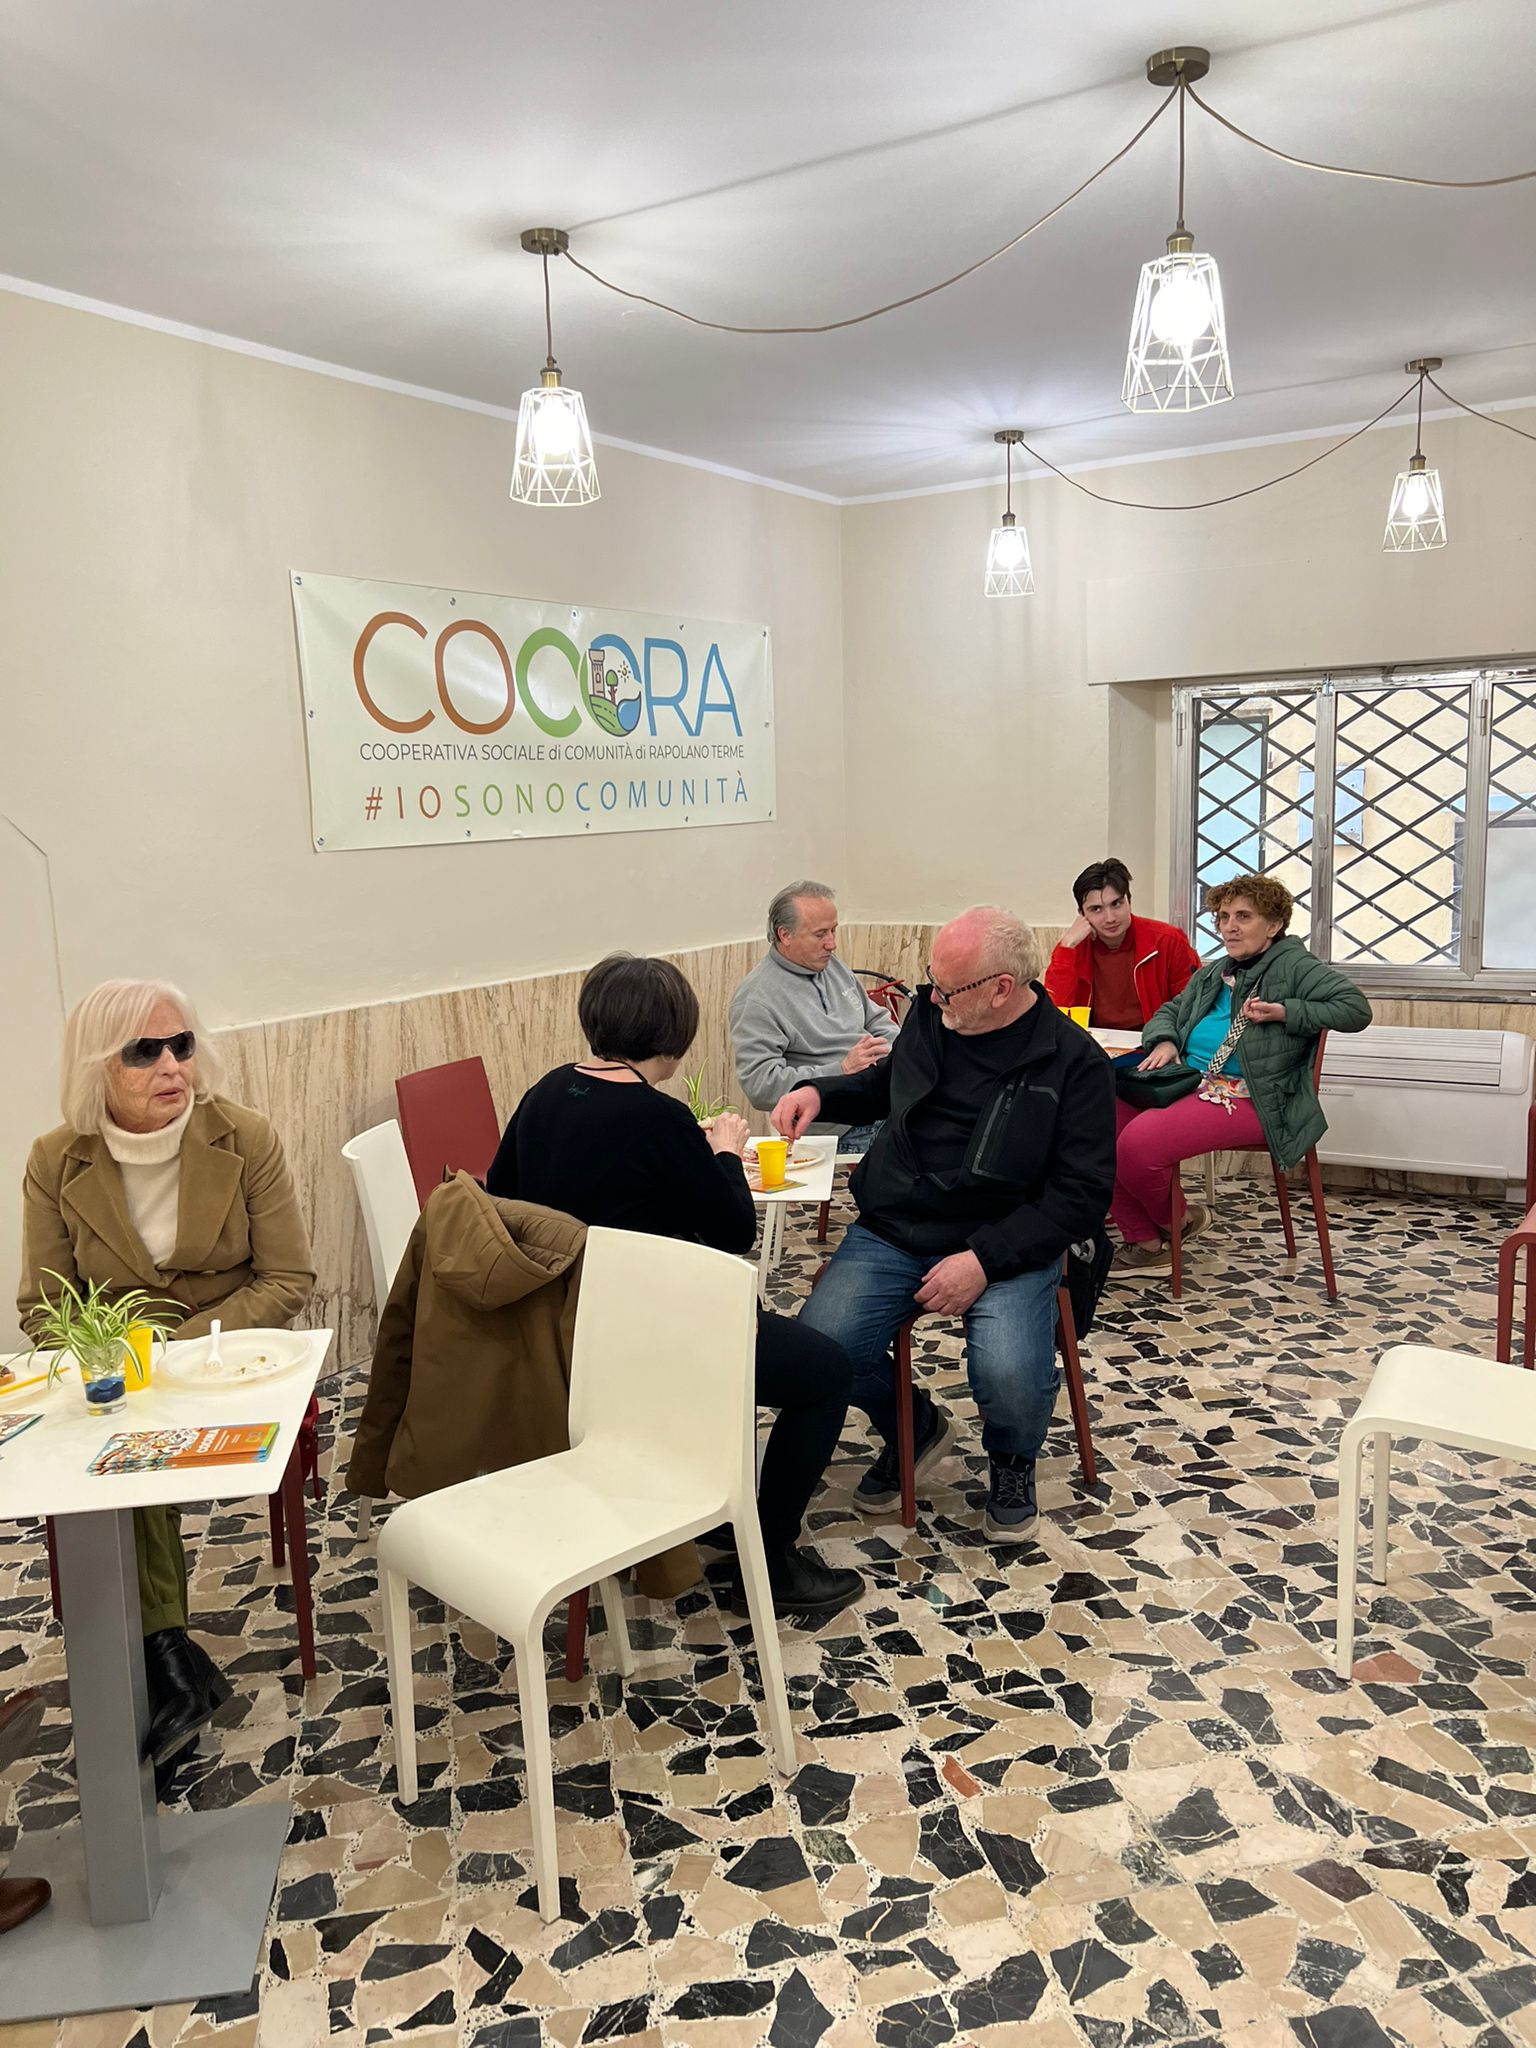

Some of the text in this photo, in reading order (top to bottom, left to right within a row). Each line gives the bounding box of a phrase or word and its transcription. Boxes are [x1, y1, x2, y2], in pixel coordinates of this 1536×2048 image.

[353, 611, 744, 738] COCORA
[359, 742, 745, 761] COOPERATIVA SOCIALE di COMUNITÀ di RAPOLANO TERME
